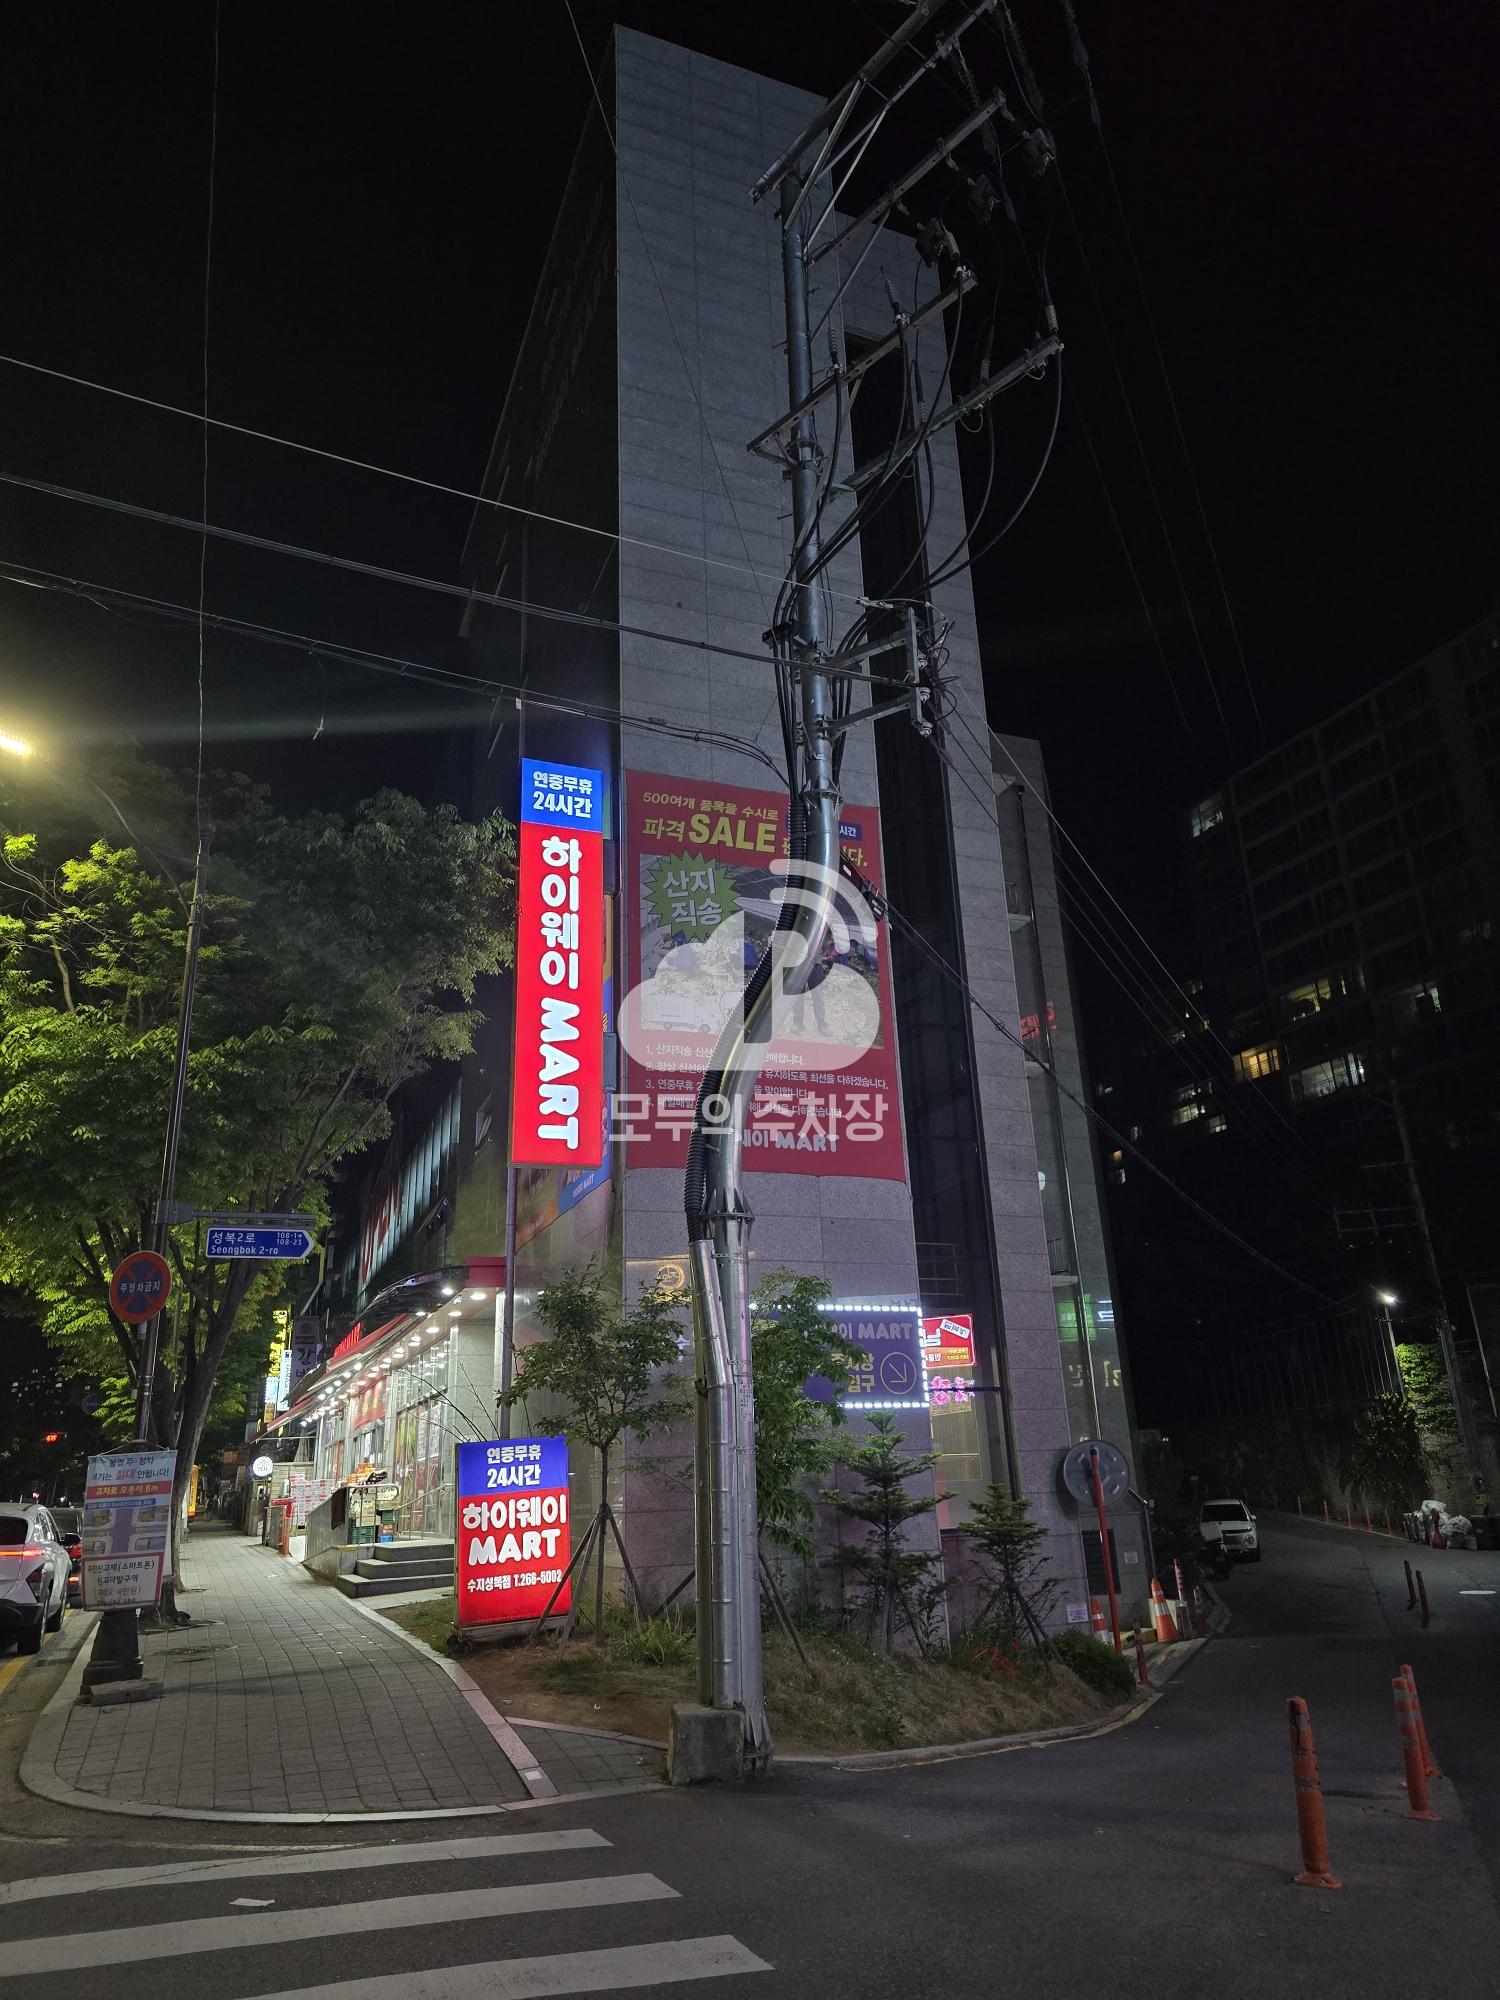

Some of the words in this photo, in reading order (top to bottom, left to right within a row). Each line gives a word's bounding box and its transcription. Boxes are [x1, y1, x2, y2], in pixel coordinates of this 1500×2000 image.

[533, 771, 593, 795] 연중무휴
[533, 791, 593, 819] 24시간
[643, 792, 695, 809] 500여개
[700, 799, 738, 815] 품목을
[742, 806, 779, 821] 수시로
[642, 818, 686, 842] 파격
[688, 813, 778, 853] SALE
[663, 868, 716, 898] 산지
[539, 836, 582, 990] 하이웨이
[671, 898, 723, 927] 직송
[656, 1044, 692, 1057] 산지직송
[537, 997, 580, 1149] MART
[810, 1072, 835, 1085] 최선을
[837, 1075, 889, 1090] 다하겠습니다.
[657, 1079, 694, 1092] 연중무휴
[775, 1131, 840, 1153] MART
[211, 1245, 256, 1256] Seongbok
[259, 1246, 279, 1255] 2-ro
[212, 1232, 255, 1245] 성복2로
[120, 1281, 161, 1294] 주정차금지
[858, 1322, 913, 1340] MART
[487, 1444, 541, 1464] 연중무휴
[487, 1464, 541, 1488] 24시간
[463, 1494, 567, 1532] 하이웨이
[468, 1528, 561, 1567] MART
[467, 1575, 512, 1593] 수지성복점
[513, 1569, 562, 1588] T.266-5002
